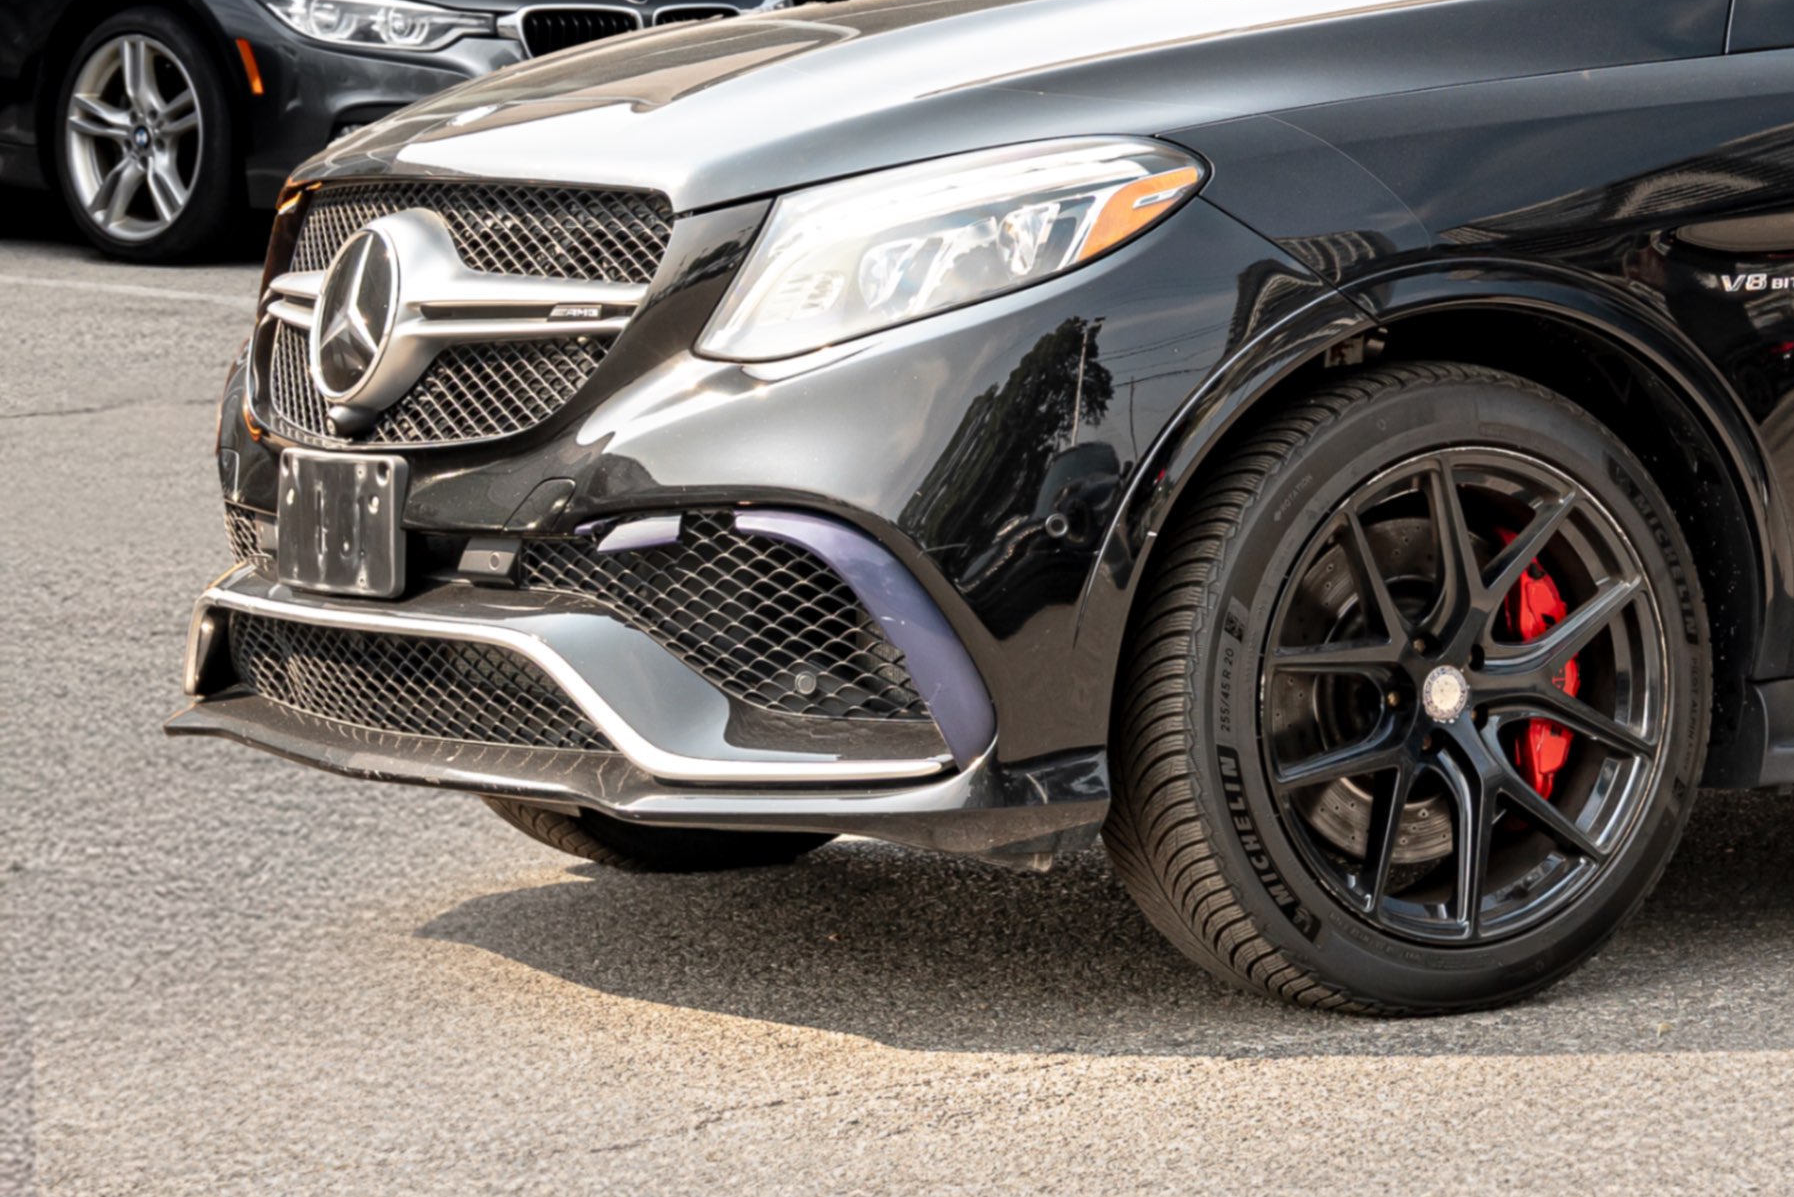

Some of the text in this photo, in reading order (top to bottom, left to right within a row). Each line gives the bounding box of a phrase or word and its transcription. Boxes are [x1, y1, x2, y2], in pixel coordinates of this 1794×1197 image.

[1721, 273, 1767, 292] V8
[1633, 494, 1699, 636] MICHELIN
[1218, 755, 1295, 907] MICHELIN
